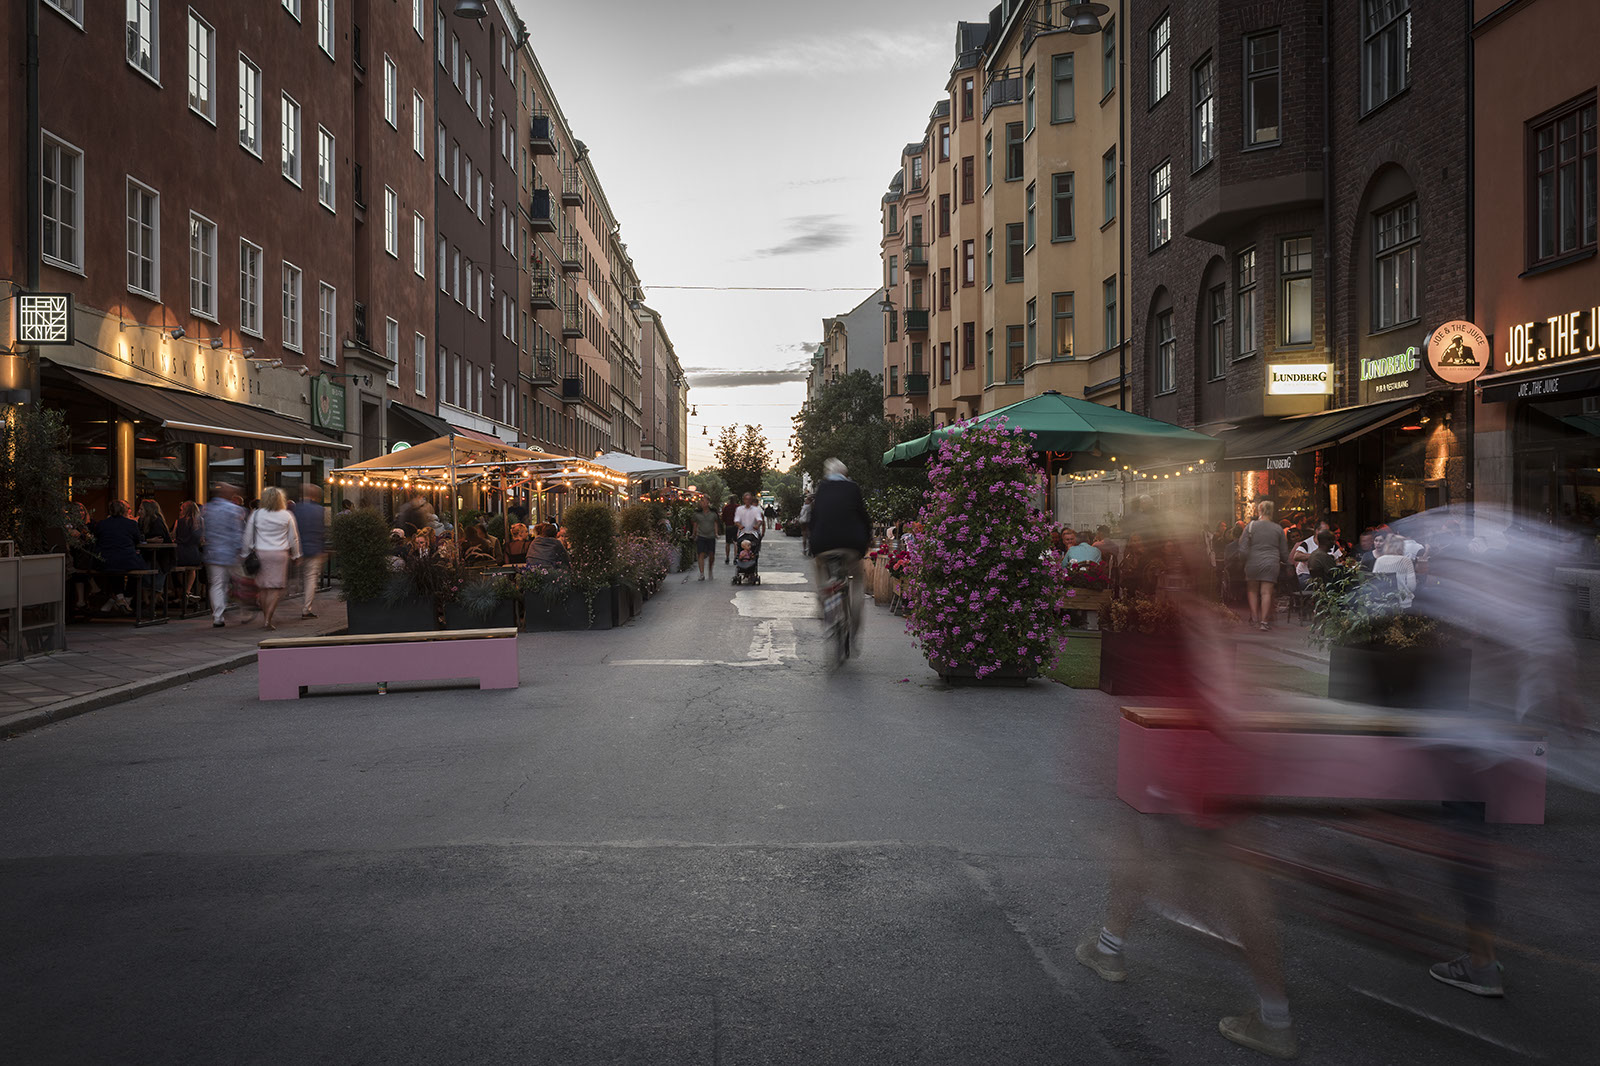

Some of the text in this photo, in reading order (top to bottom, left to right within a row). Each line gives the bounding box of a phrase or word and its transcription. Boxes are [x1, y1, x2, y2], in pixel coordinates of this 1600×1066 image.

[1433, 324, 1485, 347] JOE & THE JUICE
[1505, 306, 1600, 367] JOE & THE J
[1360, 346, 1416, 381] LUNDBERG
[215, 369, 261, 395] BURGER
[1272, 371, 1327, 382] LUNDBERG
[1517, 382, 1529, 397] JOE
[1531, 380, 1543, 395] THE
[1542, 377, 1560, 394] JUICE
